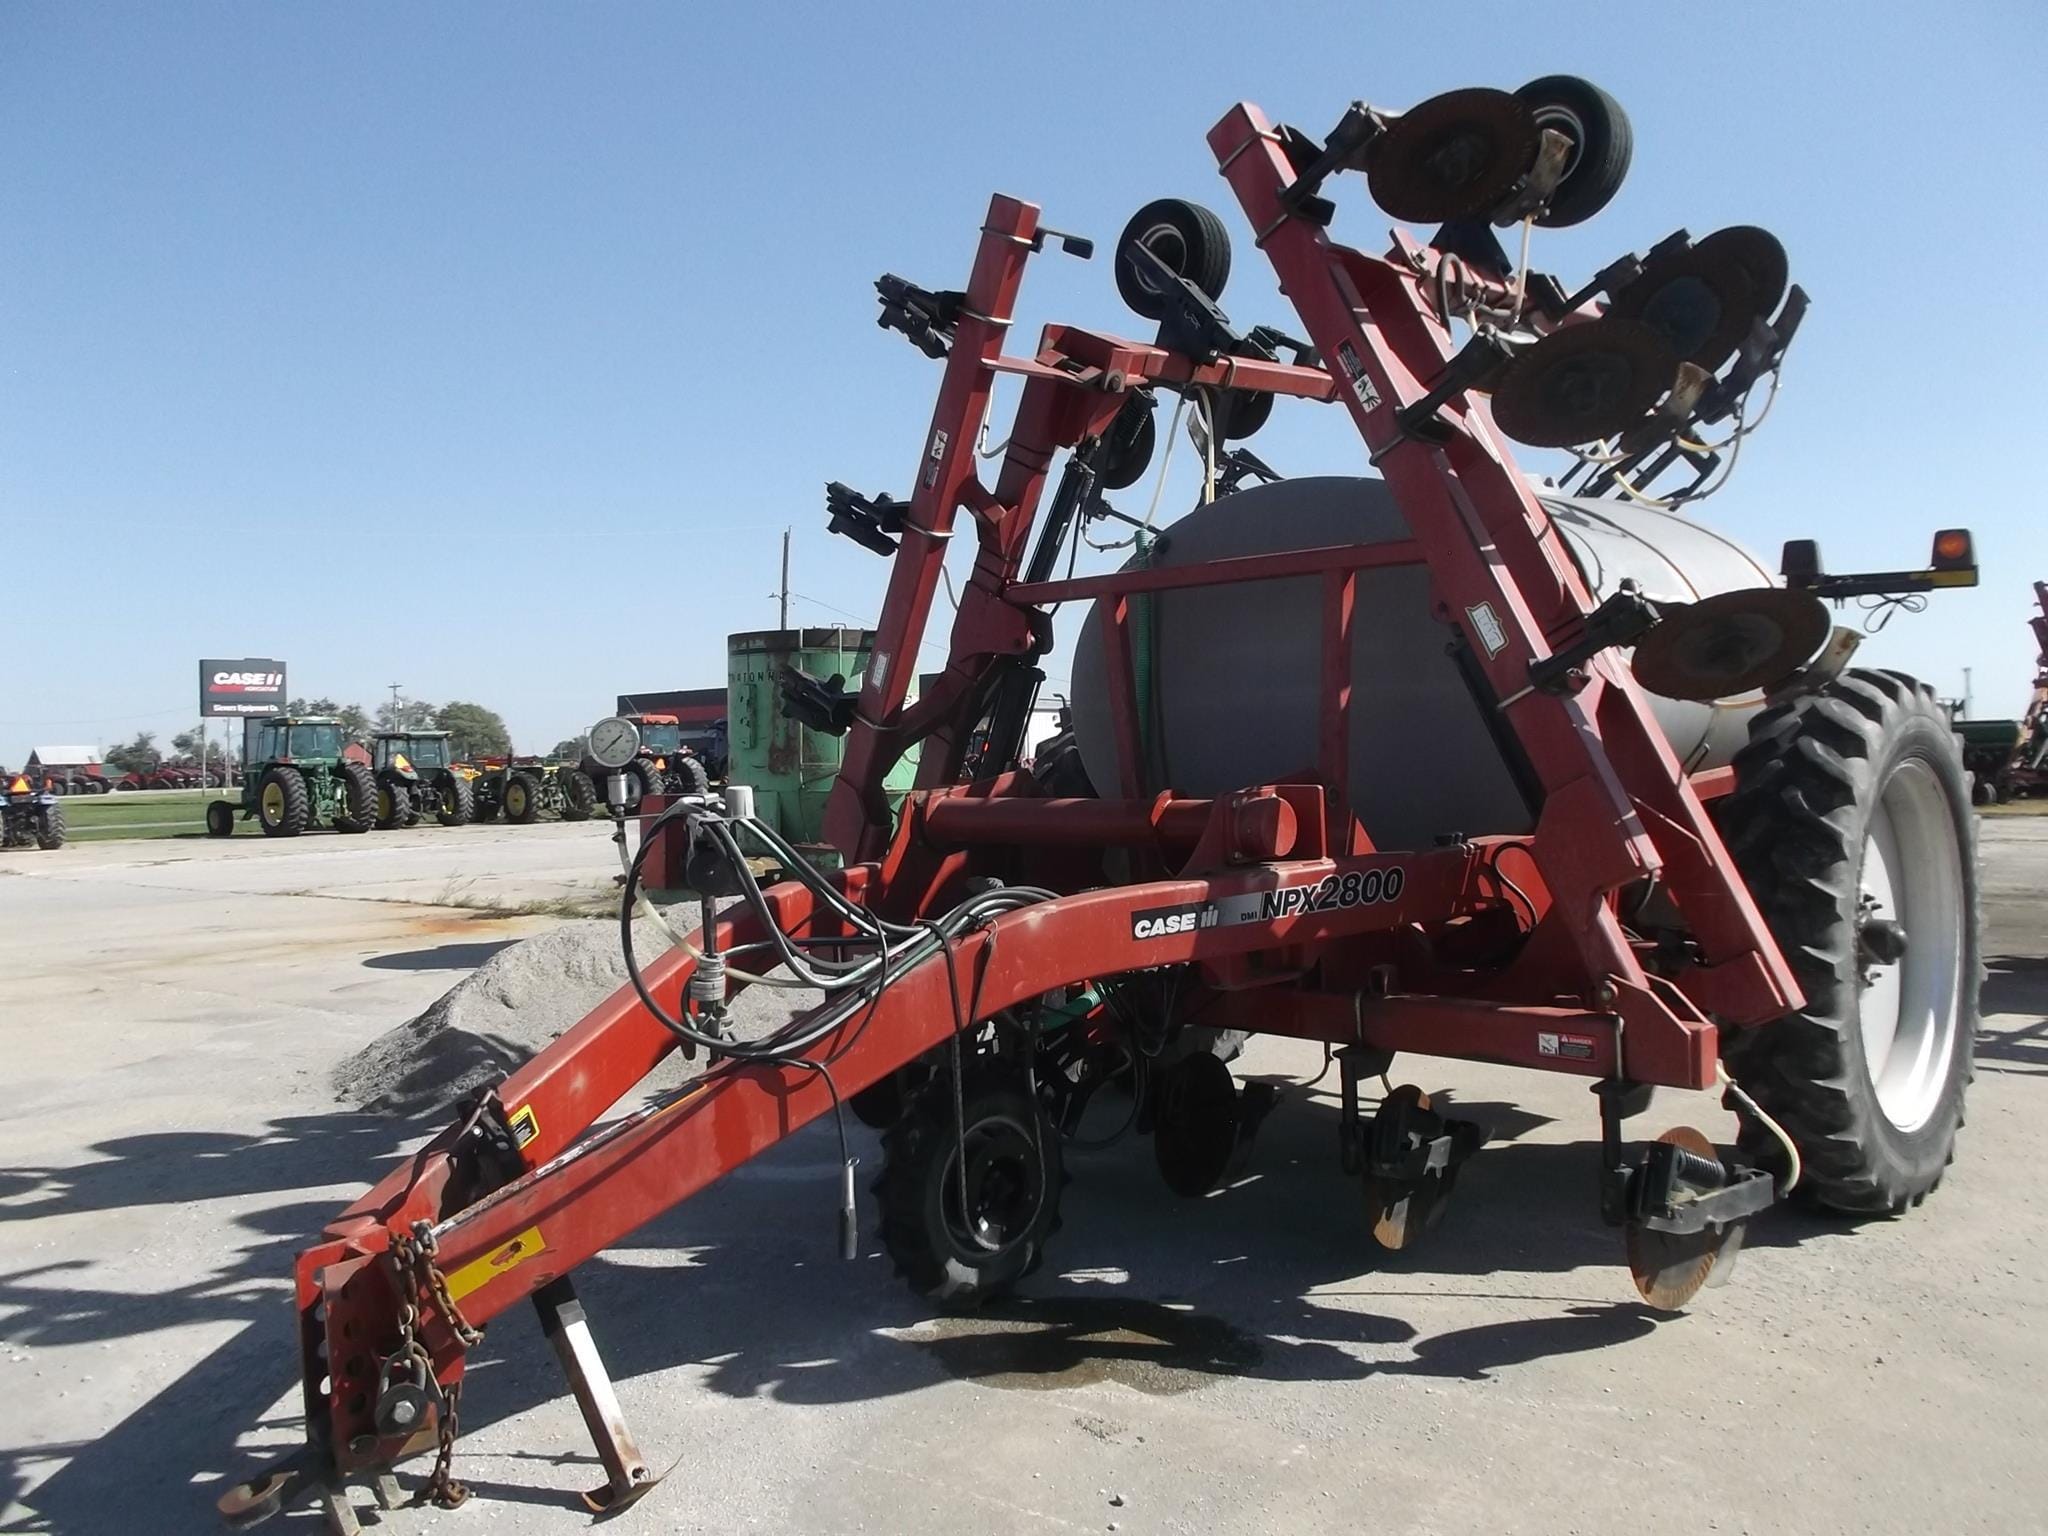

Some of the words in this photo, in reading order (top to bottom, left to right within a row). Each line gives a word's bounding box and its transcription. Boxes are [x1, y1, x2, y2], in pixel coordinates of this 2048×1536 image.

[213, 672, 266, 685] CASE
[1134, 913, 1196, 938] CASE
[1240, 911, 1258, 922] DMI
[1260, 866, 1405, 921] NPX2800
